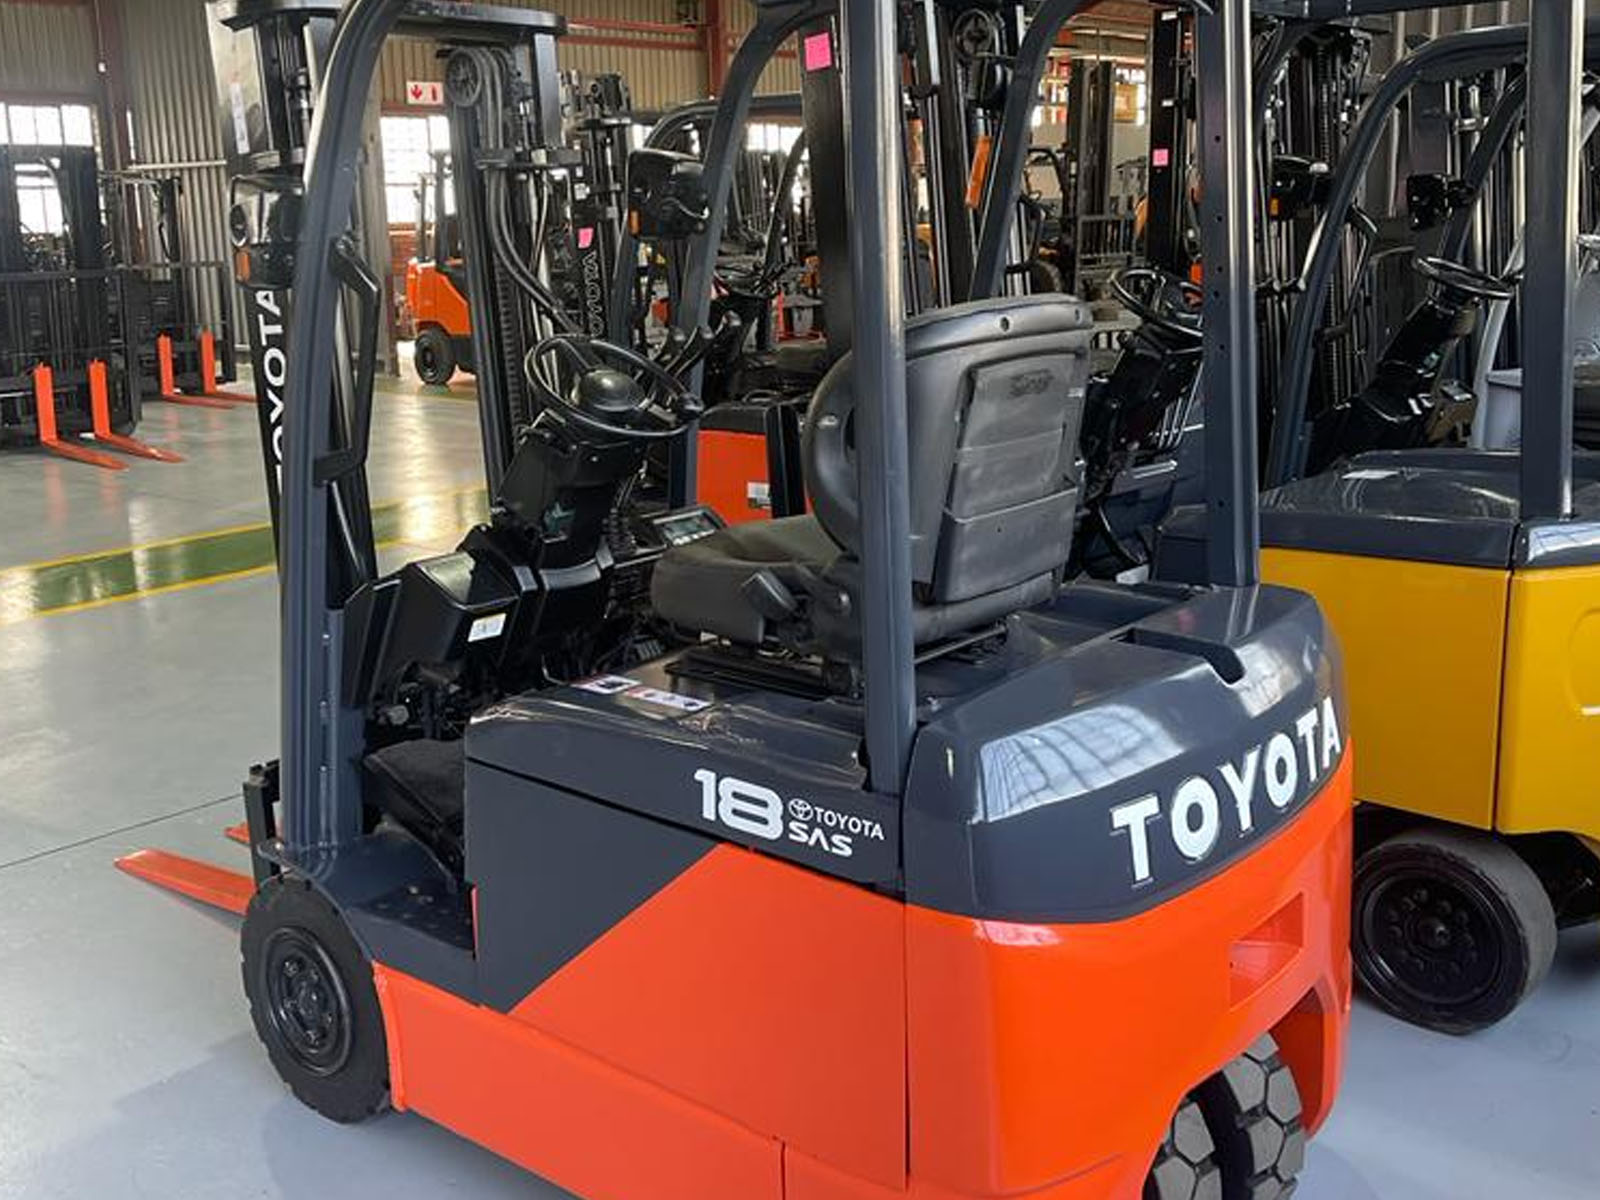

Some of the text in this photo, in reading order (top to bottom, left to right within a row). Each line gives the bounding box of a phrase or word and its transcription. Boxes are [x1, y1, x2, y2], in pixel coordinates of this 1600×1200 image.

[694, 769, 783, 840] 18
[1111, 697, 1341, 881] TOYOTA
[788, 821, 853, 857] SAS
[814, 806, 884, 841] TOYOTA
